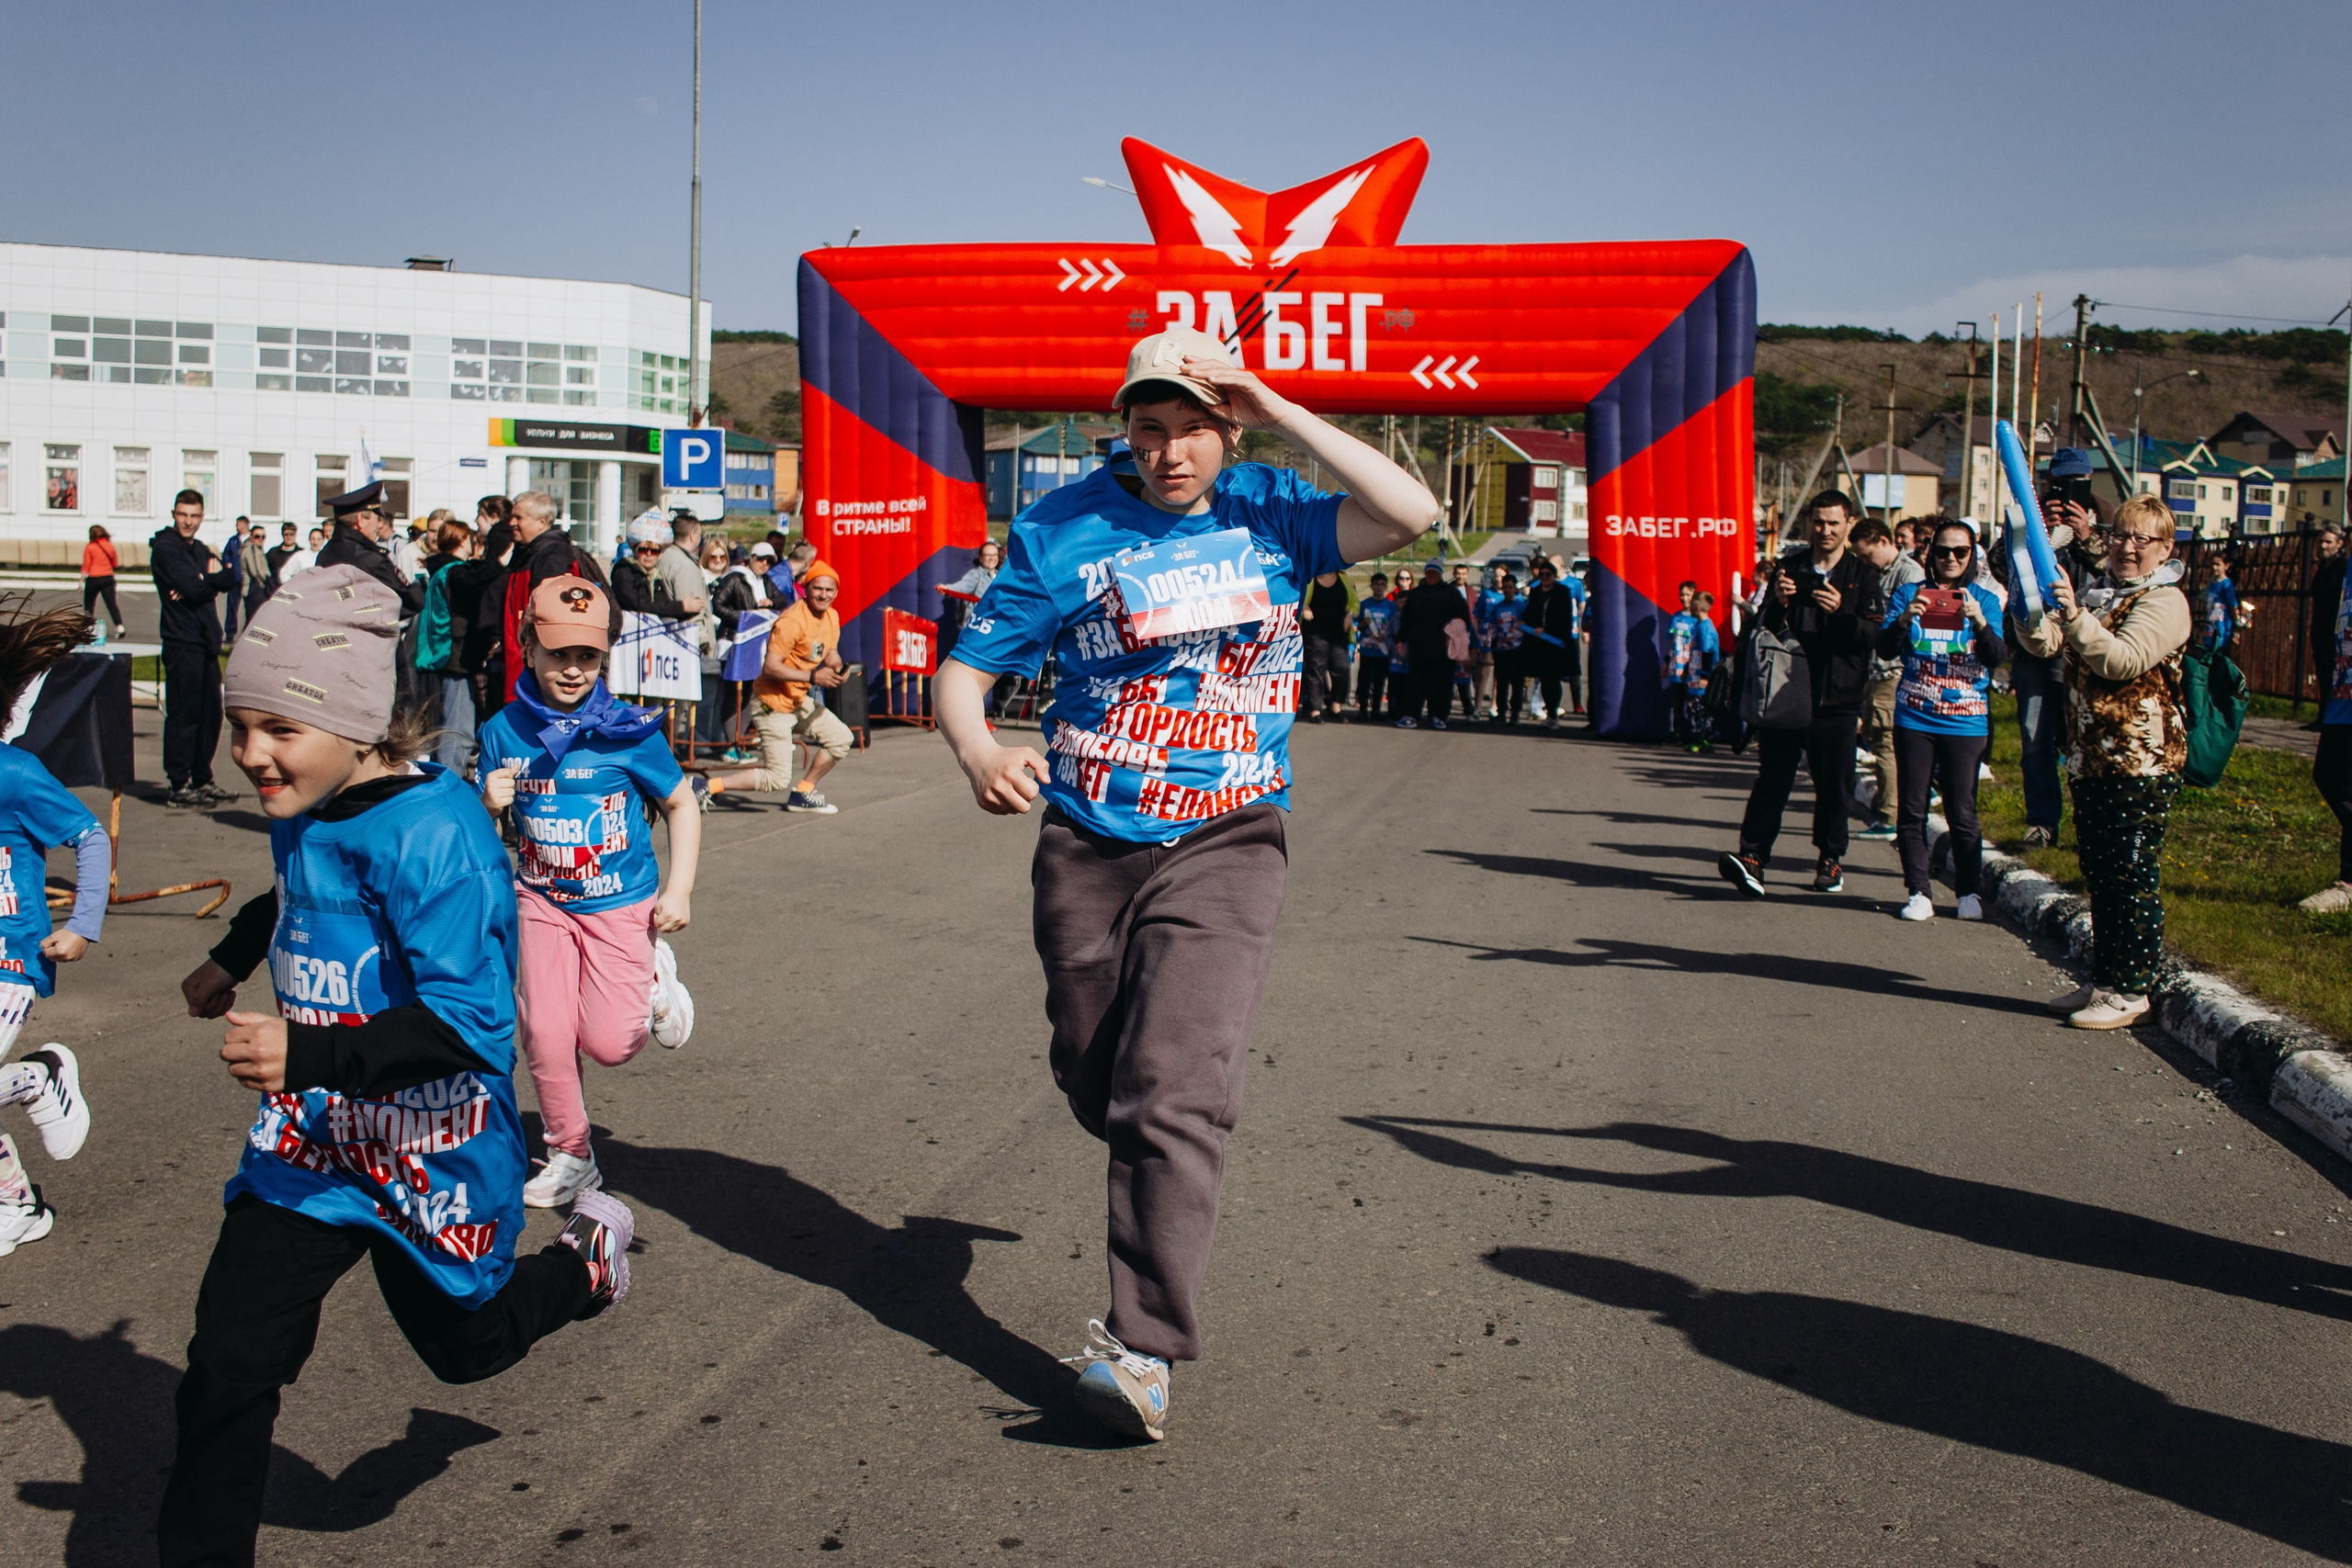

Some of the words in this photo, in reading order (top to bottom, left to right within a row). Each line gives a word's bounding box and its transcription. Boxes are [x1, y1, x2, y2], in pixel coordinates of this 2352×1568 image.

[526, 428, 556, 439] УСЛУГИ
[559, 429, 576, 439] ДЛЯ
[581, 431, 615, 441] БИЗНЕСА
[816, 499, 831, 515] В
[832, 500, 886, 517] ритме
[888, 496, 926, 513] всей
[832, 516, 911, 536] СТРАНЫ!
[1605, 514, 1737, 538] ЗАБЕГ.РФ
[1134, 551, 1155, 562] ПСБ
[1148, 559, 1238, 603] 00524
[968, 613, 995, 634] СБ
[655, 654, 680, 681] ПСБ
[1168, 635, 1304, 678] #ЗАБЕГ202
[286, 682, 324, 701] CREATOR
[525, 816, 582, 843] 00503
[582, 872, 624, 897] 2024
[276, 946, 350, 1006] 00526
[328, 1093, 492, 1156] #МОМЕНТ
